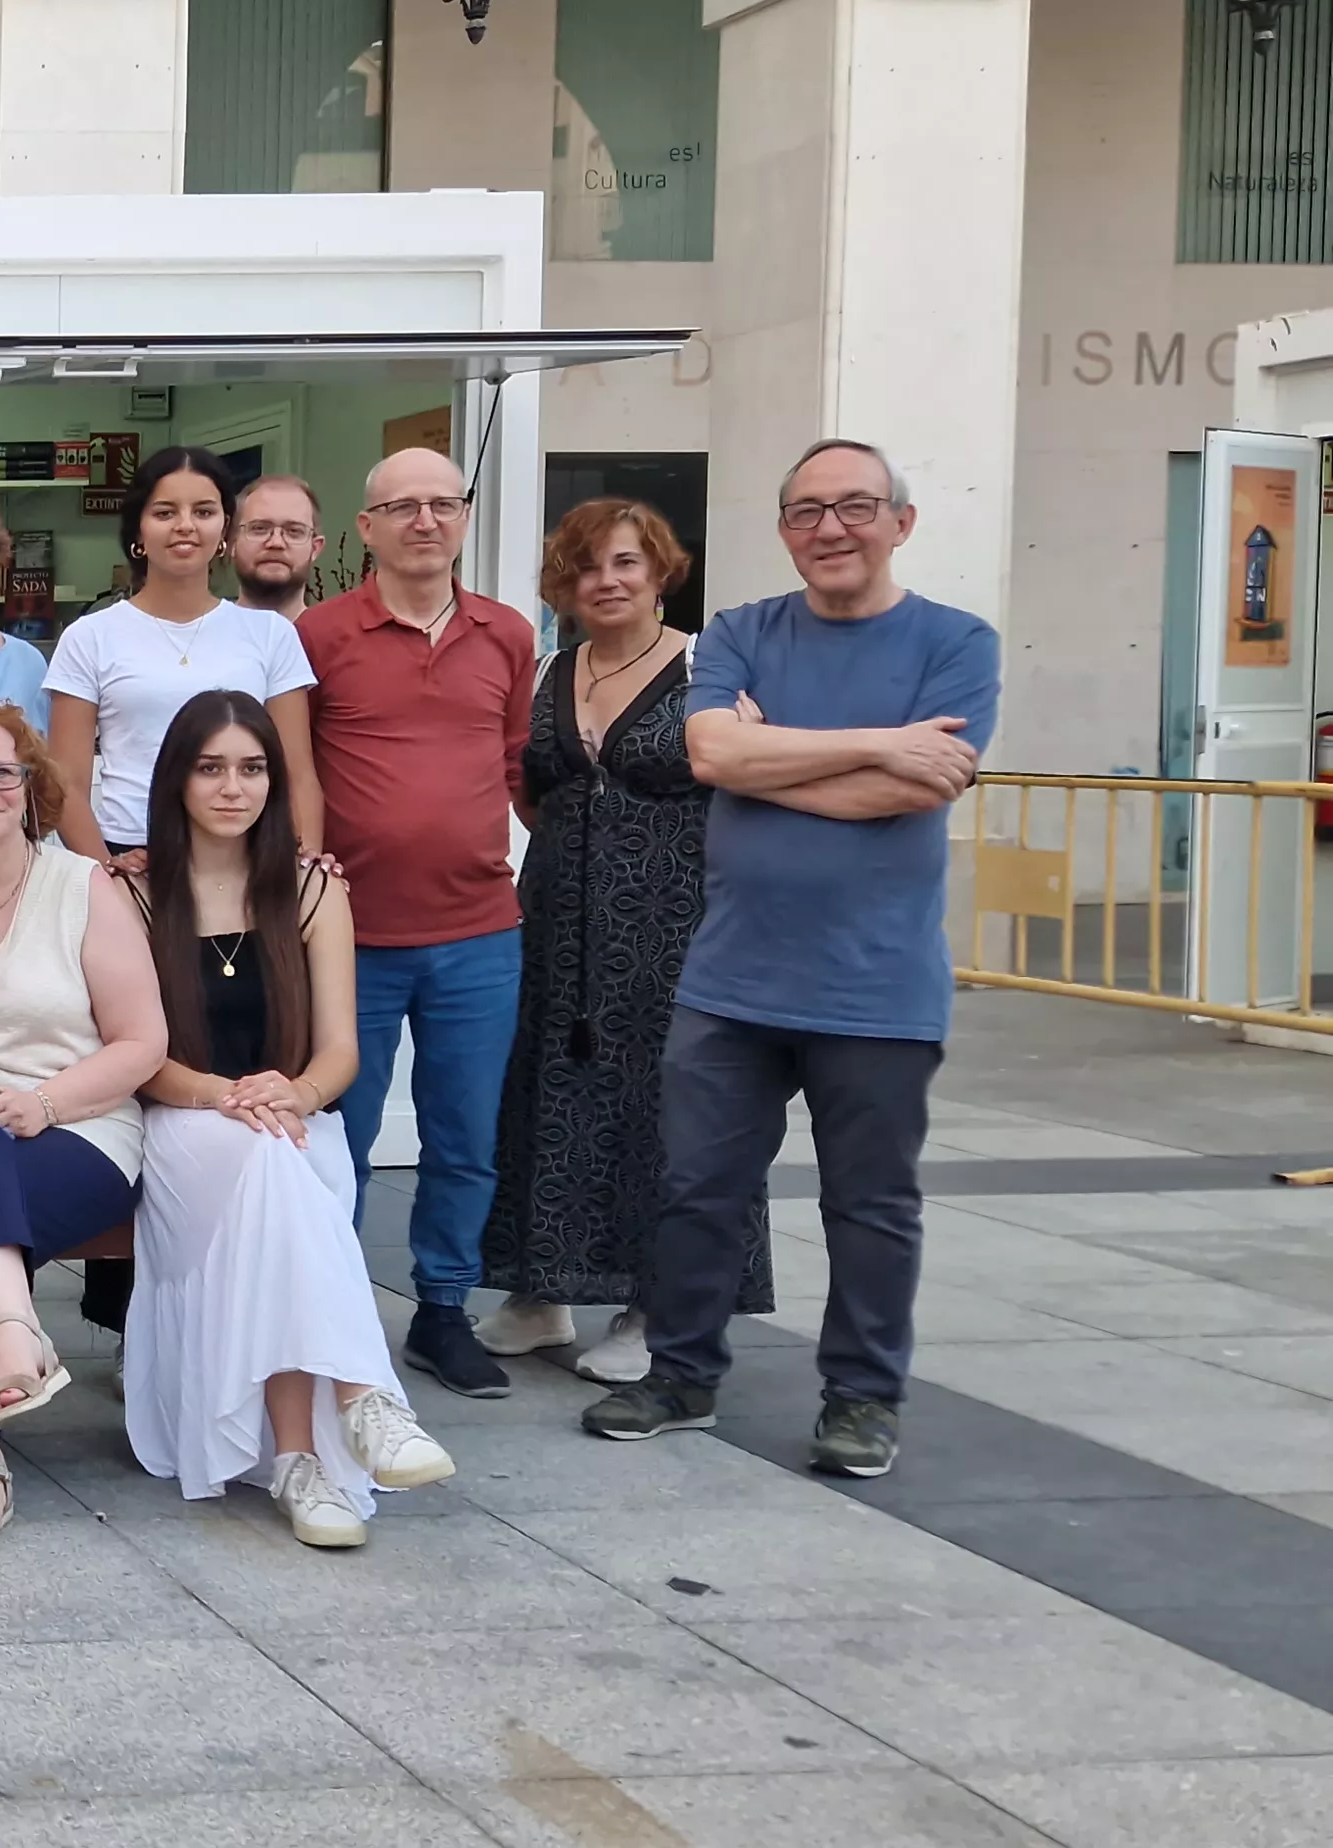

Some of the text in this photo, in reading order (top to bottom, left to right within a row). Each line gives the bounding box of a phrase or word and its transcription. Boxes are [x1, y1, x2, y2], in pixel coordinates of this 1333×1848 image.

[584, 168, 667, 191] Cultura
[1208, 170, 1319, 194] Naturaleza
[1040, 329, 1239, 387] ISMO
[85, 497, 124, 510] EXTINT
[12, 579, 48, 593] SADA
